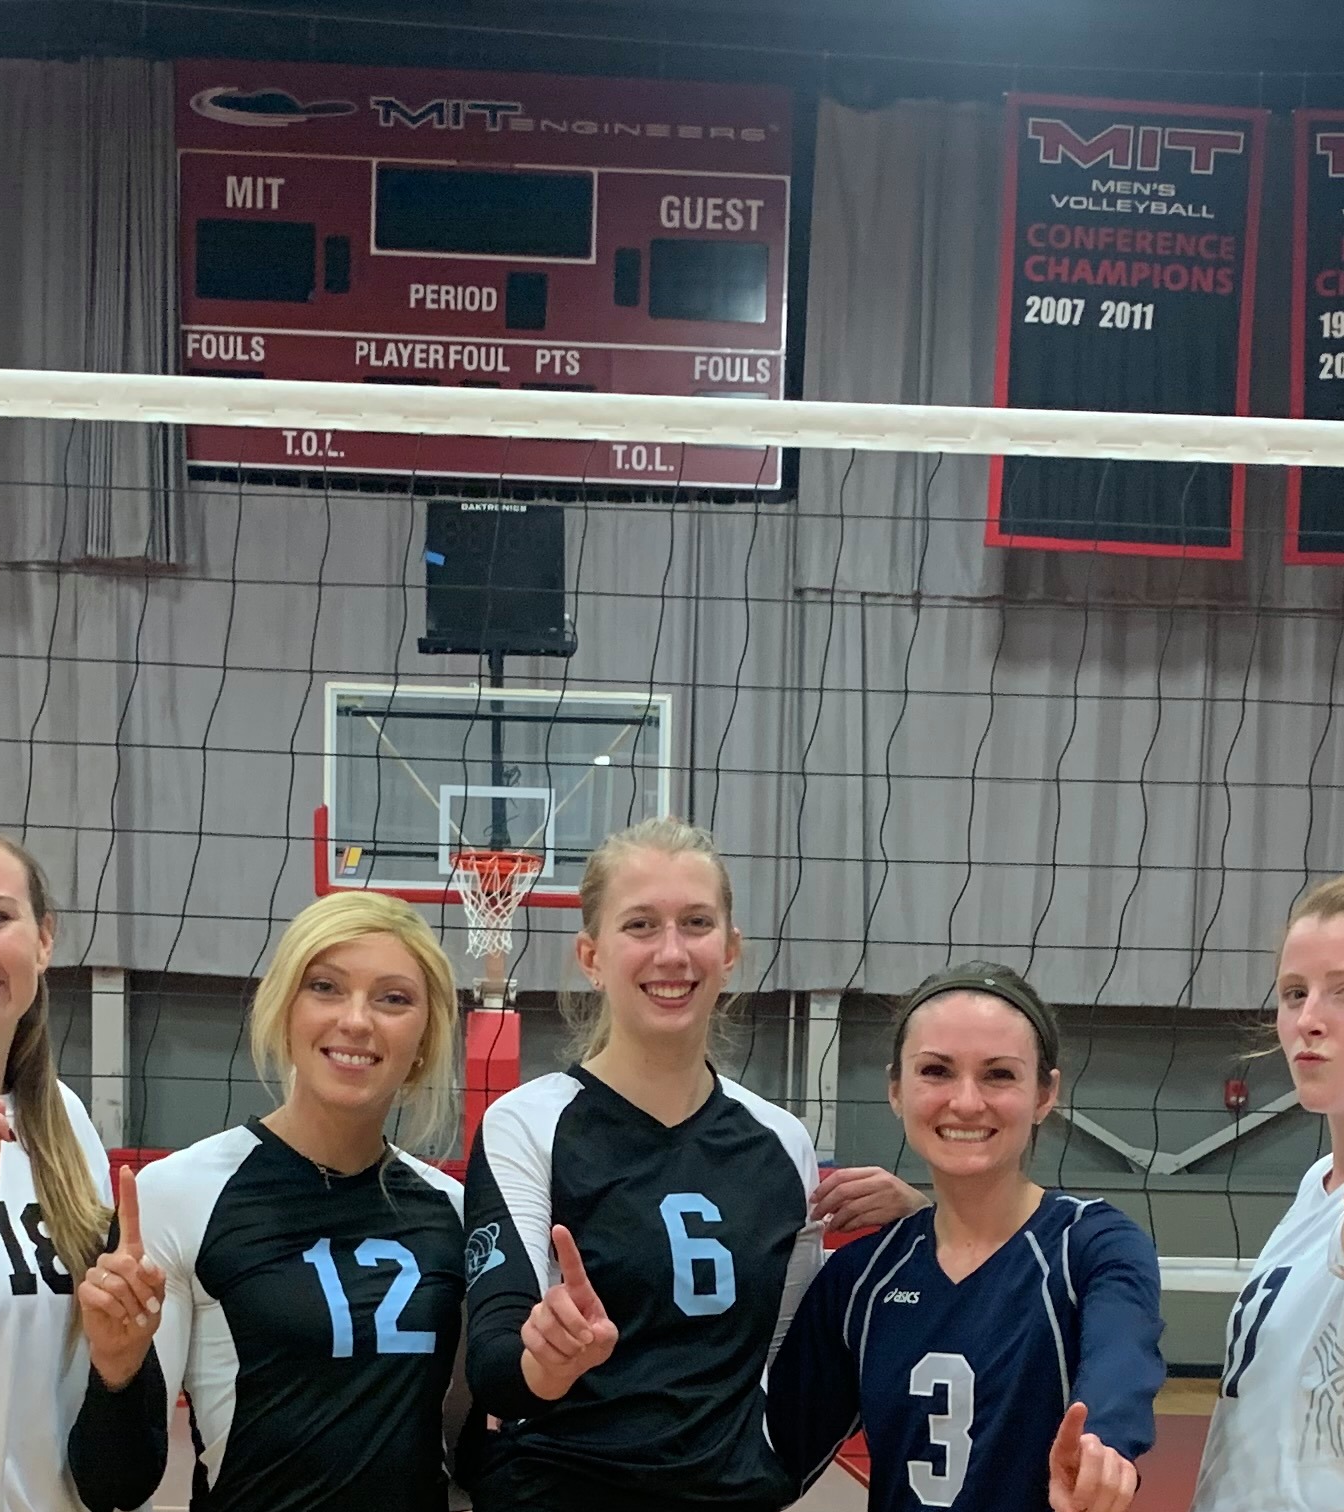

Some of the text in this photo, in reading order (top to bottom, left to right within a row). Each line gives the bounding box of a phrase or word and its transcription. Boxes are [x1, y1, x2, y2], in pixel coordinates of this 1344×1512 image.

[370, 95, 766, 142] MIT ENGINEERS
[1028, 118, 1244, 175] MIT
[225, 176, 285, 210] MIT
[1091, 179, 1176, 197] MEN'S
[660, 195, 765, 232] GUEST
[1051, 195, 1215, 218] VOLLEYBALL
[1026, 223, 1235, 261] CONFERENCE
[1024, 255, 1234, 296] CHAMPIONS
[409, 284, 498, 313] PERIOD
[1024, 296, 1154, 330] 2007 2011
[186, 333, 266, 362] FOULS
[355, 341, 581, 376] PLAYER FOUL PTS
[694, 355, 771, 384] FOULS
[282, 430, 346, 459] T.O.L.
[612, 444, 676, 474] T.O.L.
[660, 1193, 735, 1316] 6
[303, 1238, 436, 1358] 12
[908, 1352, 976, 1508] 3
